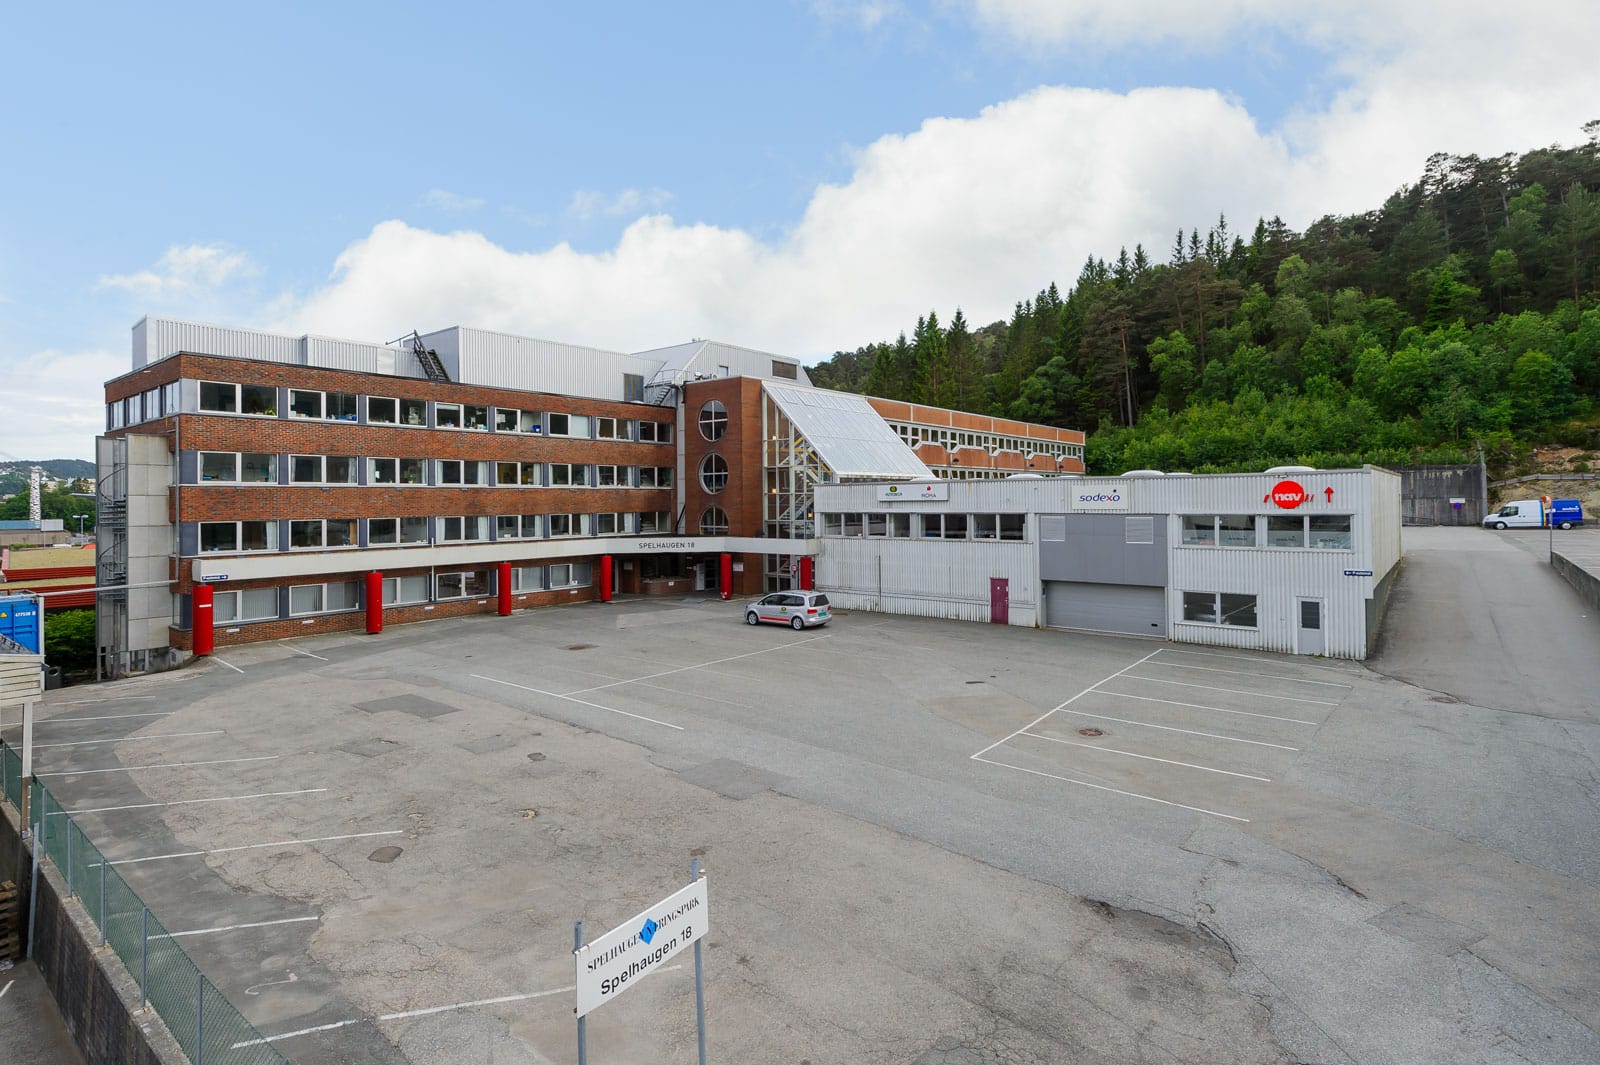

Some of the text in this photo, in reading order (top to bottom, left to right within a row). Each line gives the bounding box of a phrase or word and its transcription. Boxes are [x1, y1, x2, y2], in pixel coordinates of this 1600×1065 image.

[1079, 490, 1121, 502] sodexo
[1274, 492, 1303, 502] nav
[601, 926, 692, 995] Spelhaugen 18
